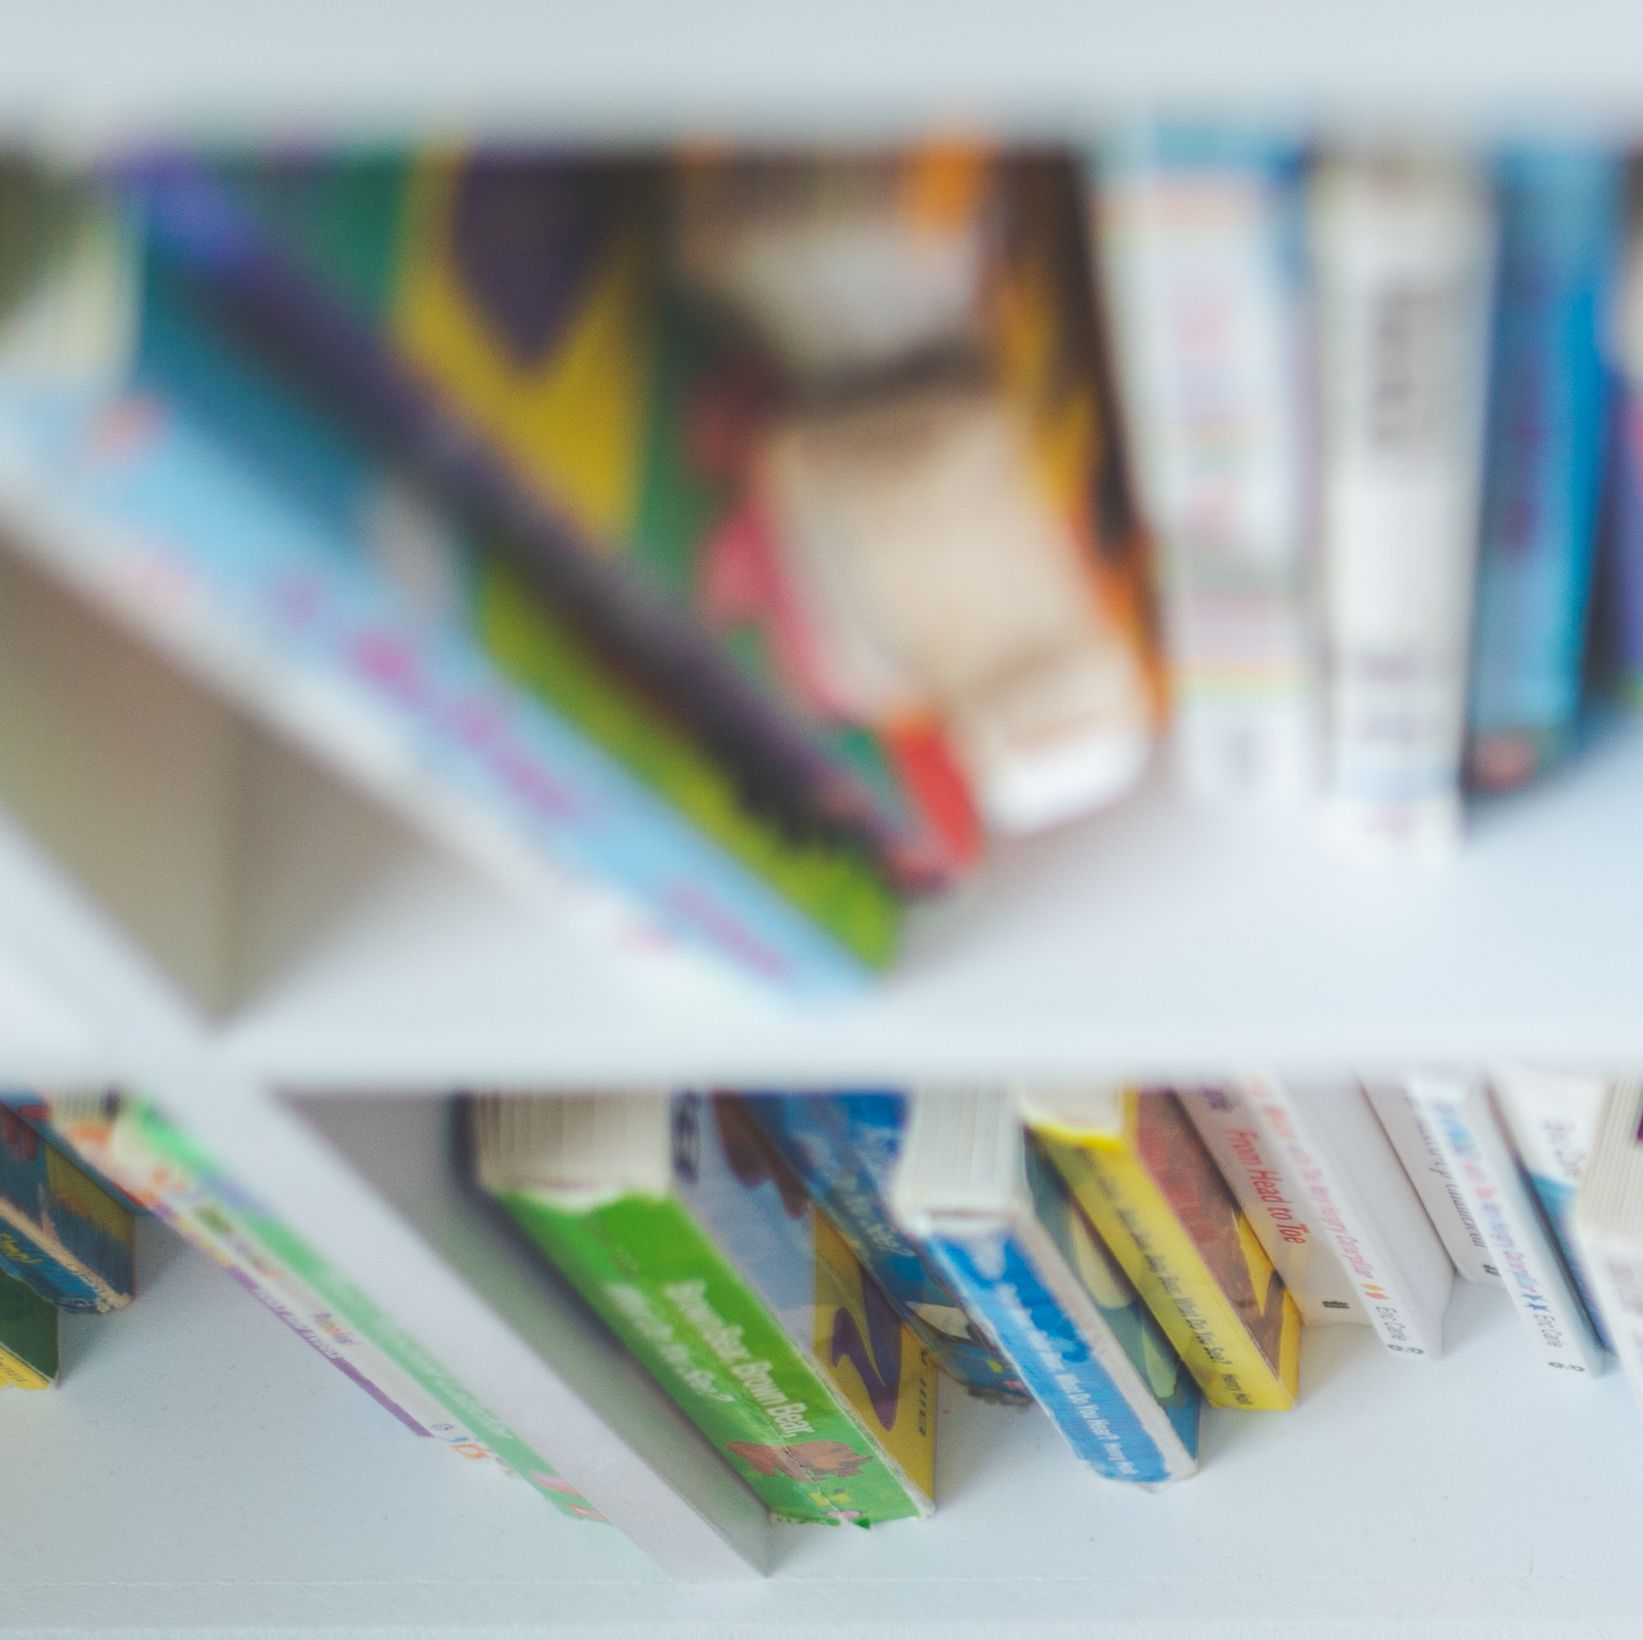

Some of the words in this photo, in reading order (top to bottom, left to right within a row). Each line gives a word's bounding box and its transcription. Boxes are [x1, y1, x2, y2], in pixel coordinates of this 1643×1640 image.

[1247, 1168, 1288, 1203] Head
[1267, 1206, 1292, 1221] to
[1277, 1223, 1311, 1244] Toe
[767, 1402, 816, 1438] Bear,
